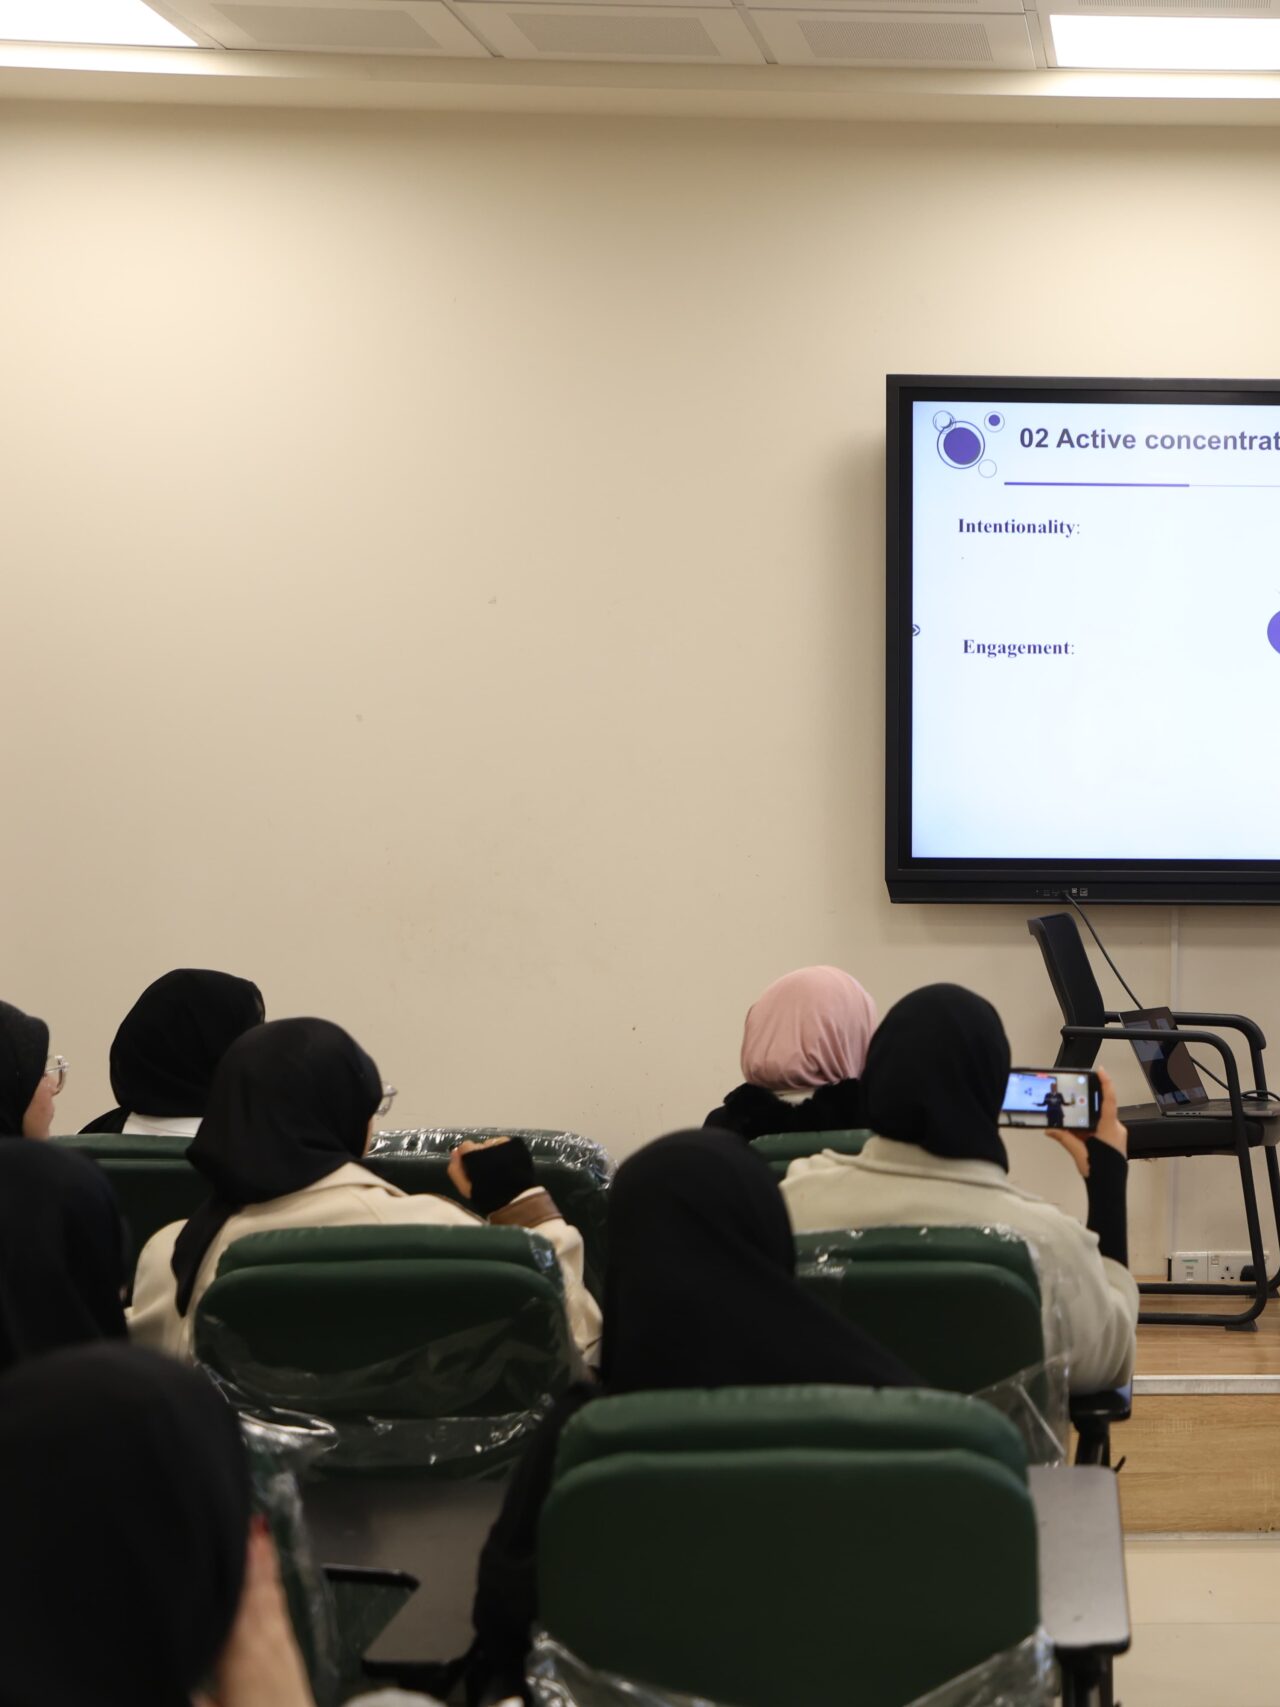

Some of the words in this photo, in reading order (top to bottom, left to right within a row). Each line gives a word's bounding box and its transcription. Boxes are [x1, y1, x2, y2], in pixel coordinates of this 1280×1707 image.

[1019, 427, 1049, 449] 02
[1056, 428, 1136, 450] Active
[958, 518, 1081, 539] Intentionality:
[963, 639, 1075, 659] Engagement:
